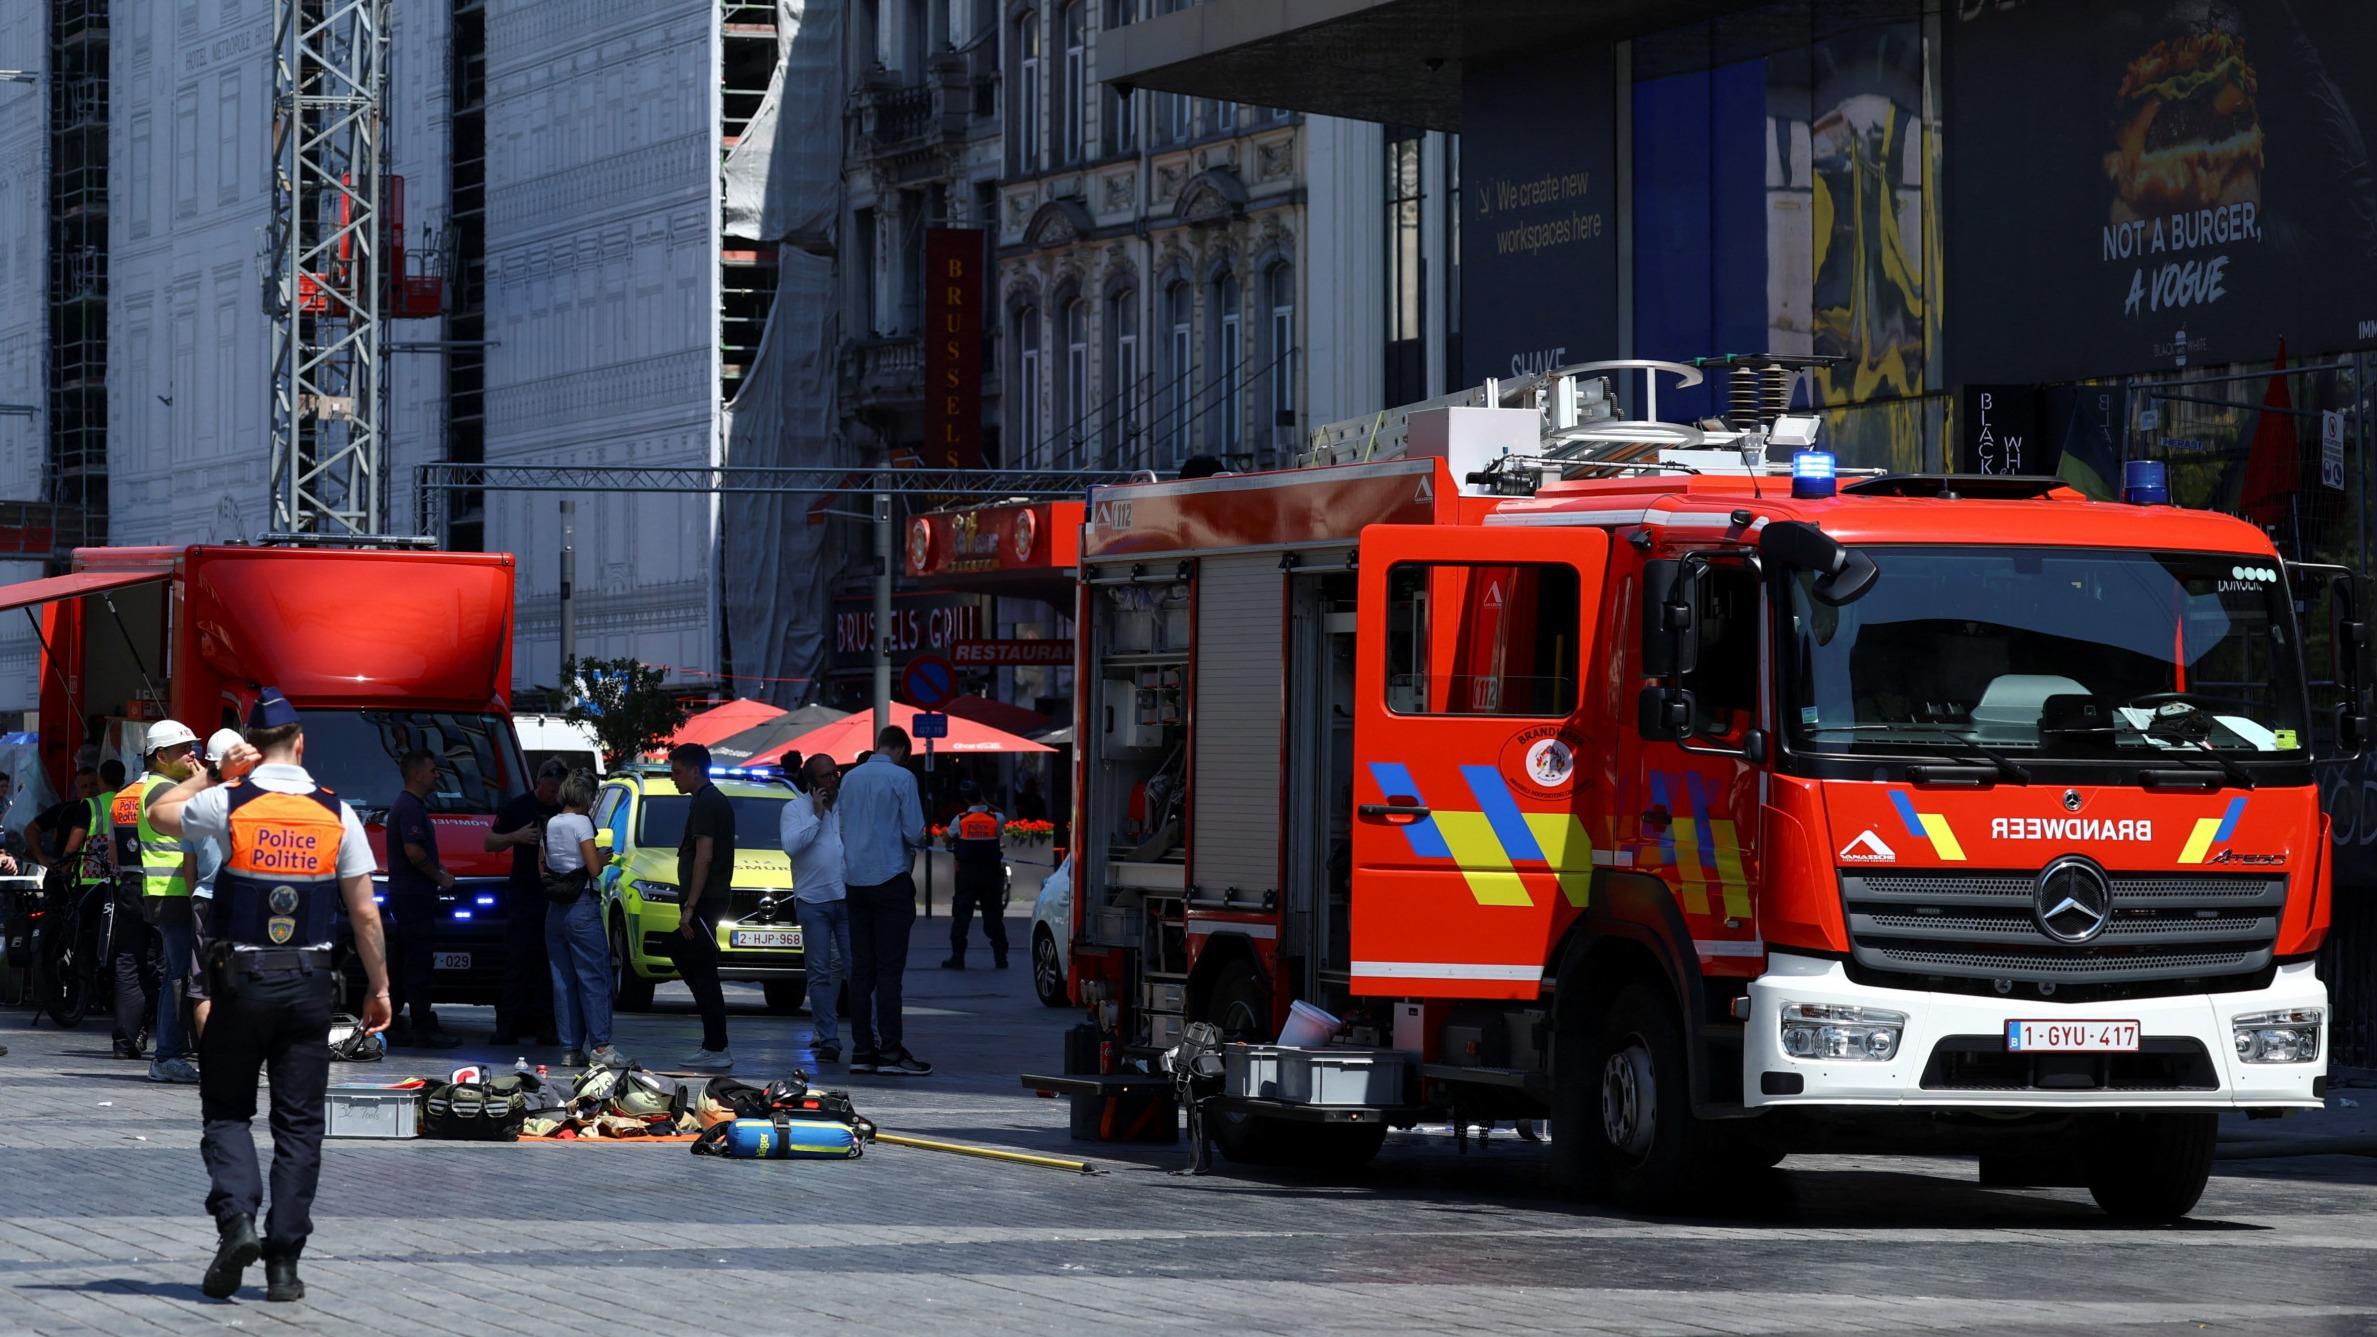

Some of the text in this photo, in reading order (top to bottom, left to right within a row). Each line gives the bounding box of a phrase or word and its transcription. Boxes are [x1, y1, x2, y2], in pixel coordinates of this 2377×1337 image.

[185, 46, 207, 73] HOTEL
[1497, 171, 1589, 211] We create new
[1497, 209, 1601, 256] workspaces here
[2103, 201, 2262, 262] NOT A BURGER,
[2124, 255, 2231, 320] A VOGUE
[946, 257, 963, 468] BRUSSELS
[1511, 347, 1566, 377] SHAKE
[1978, 392, 1995, 474] BLACK
[1117, 502, 1132, 528] 112
[837, 609, 920, 653] BRUSELS
[955, 644, 1075, 662] RESTAURAN
[118, 811, 138, 823] Polit
[119, 800, 139, 811] Polic
[258, 829, 316, 849] Police
[252, 849, 318, 870] Politie
[740, 933, 800, 945] 2-HJP-968
[2025, 1026, 2135, 1046] 1-GYU-417
